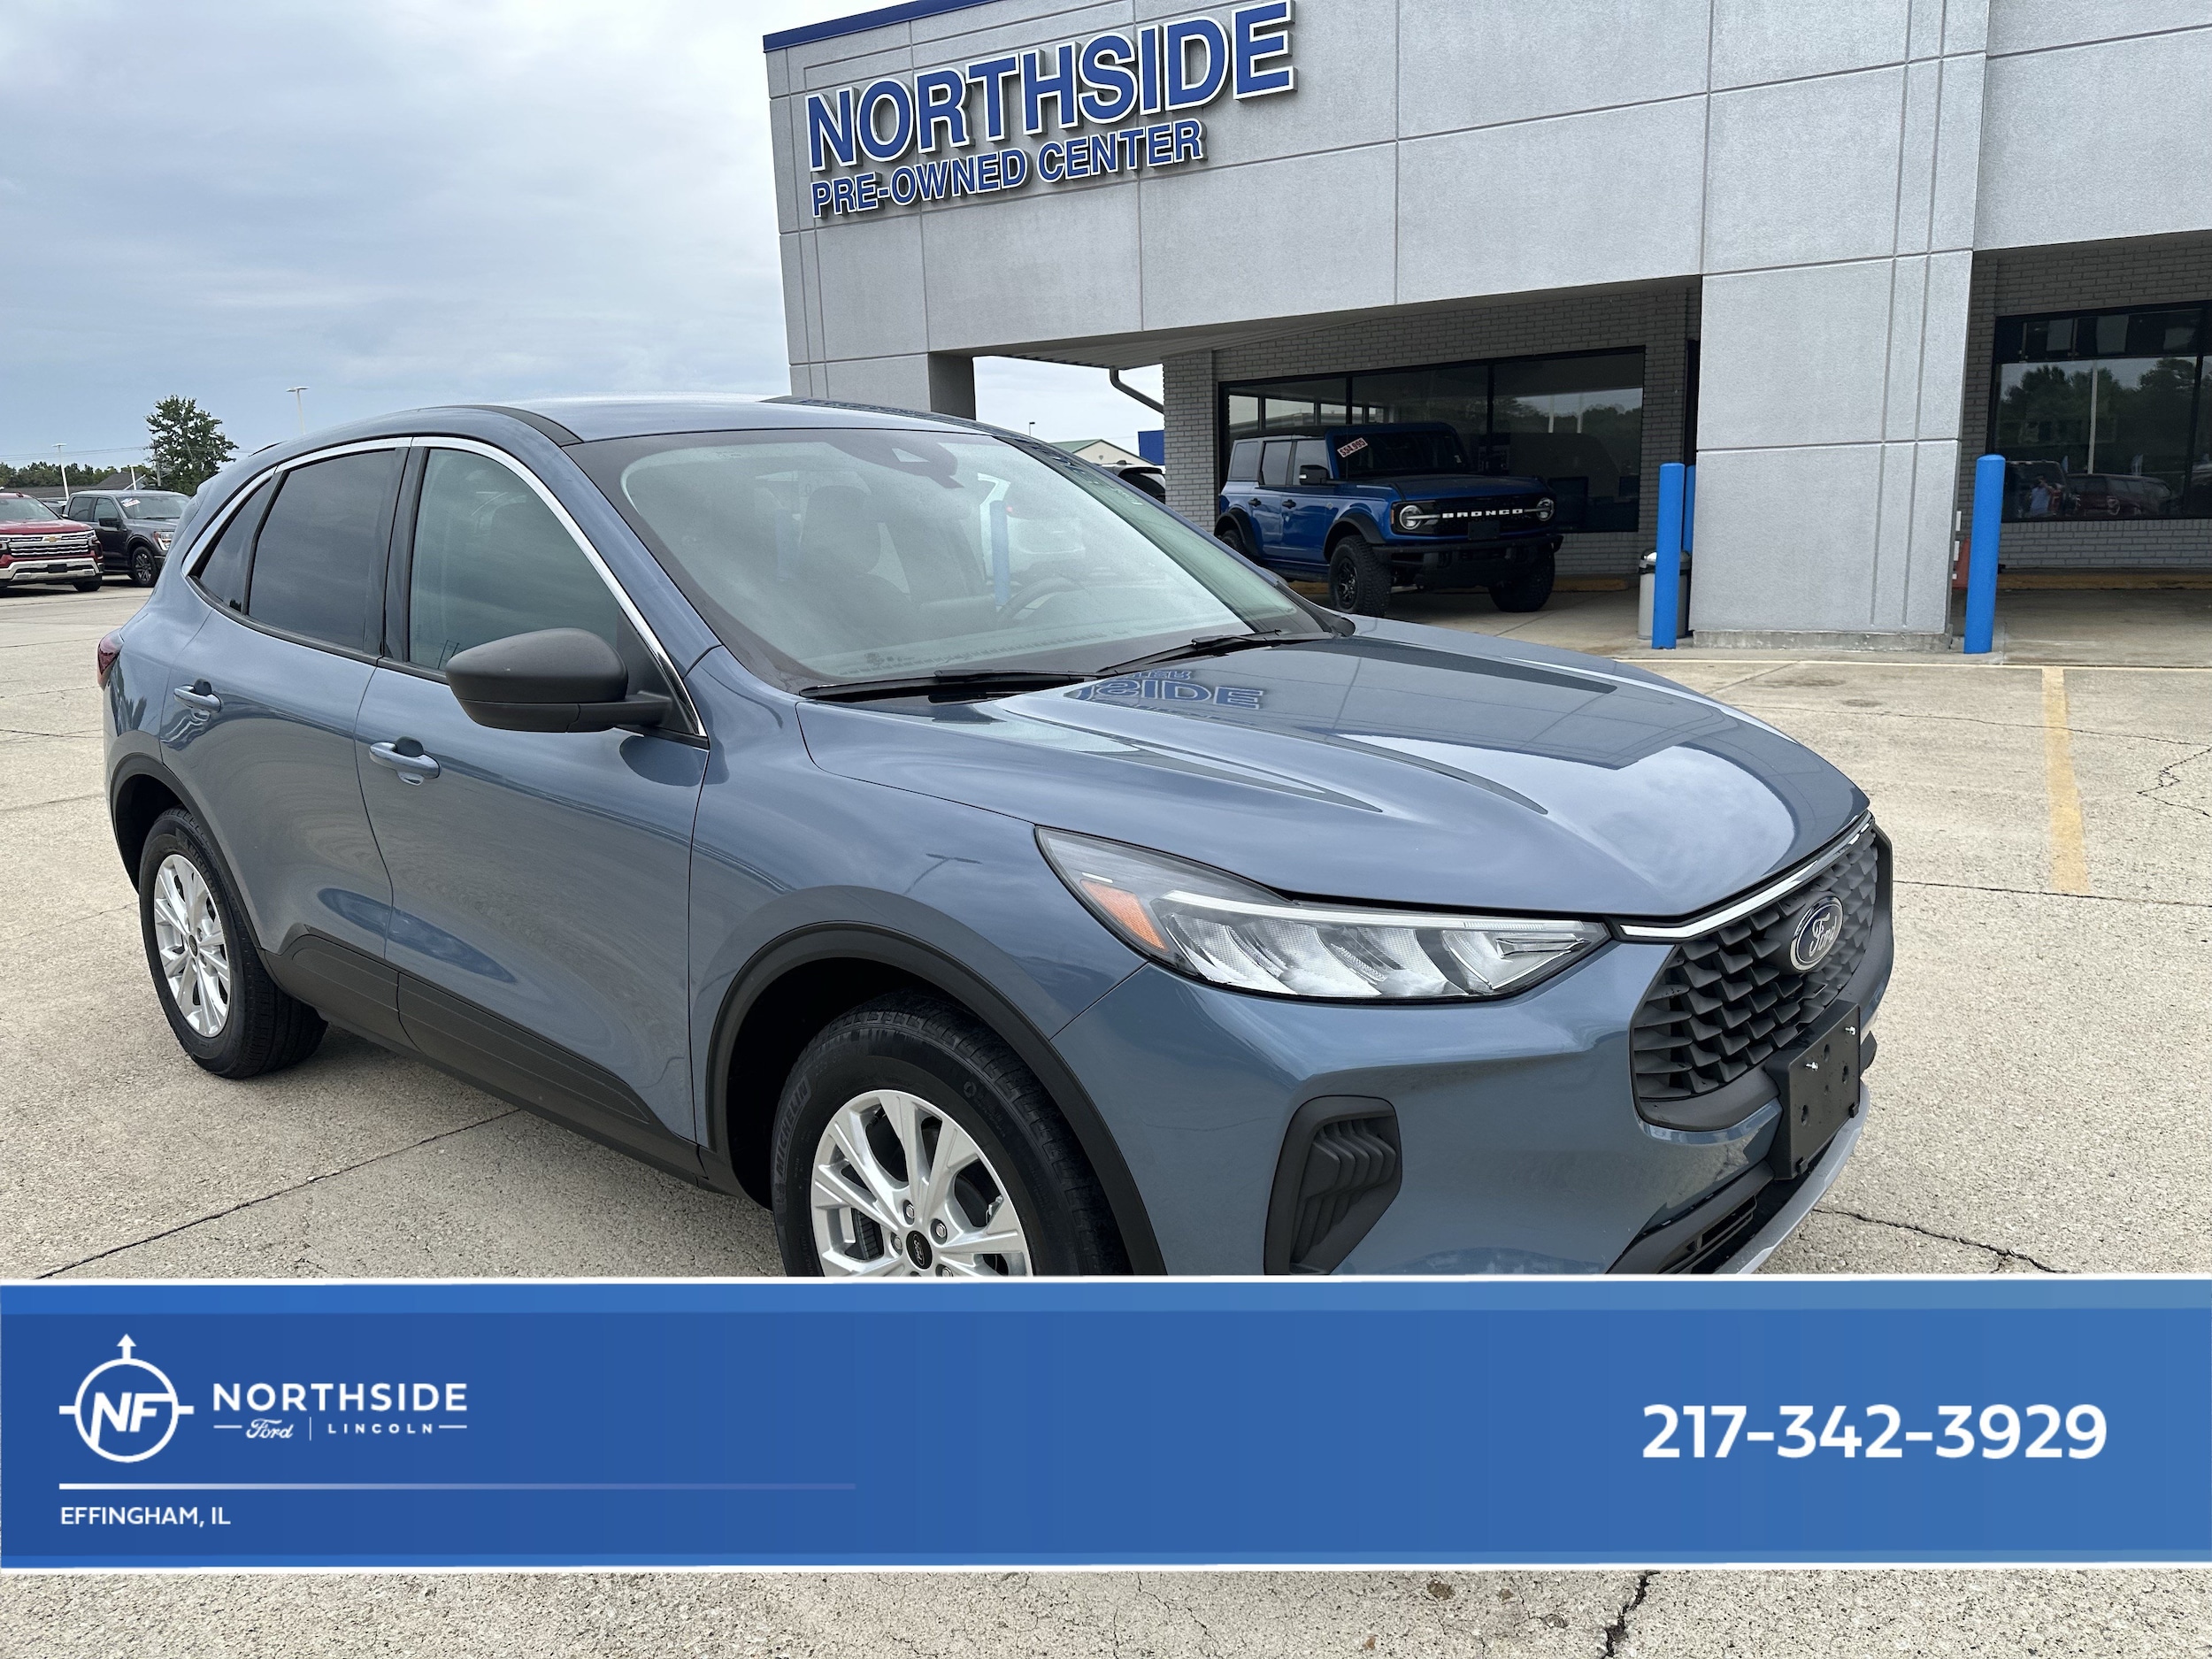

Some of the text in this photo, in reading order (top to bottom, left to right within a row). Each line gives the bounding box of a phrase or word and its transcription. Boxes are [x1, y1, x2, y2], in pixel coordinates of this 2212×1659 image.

[805, 1, 1295, 173] NORTHSIDE
[810, 119, 1207, 219] PRE-OWNED CENTER
[1442, 508, 1523, 519] BRONCO
[1809, 912, 1838, 957] Ford
[775, 1076, 810, 1179] MICHELIN
